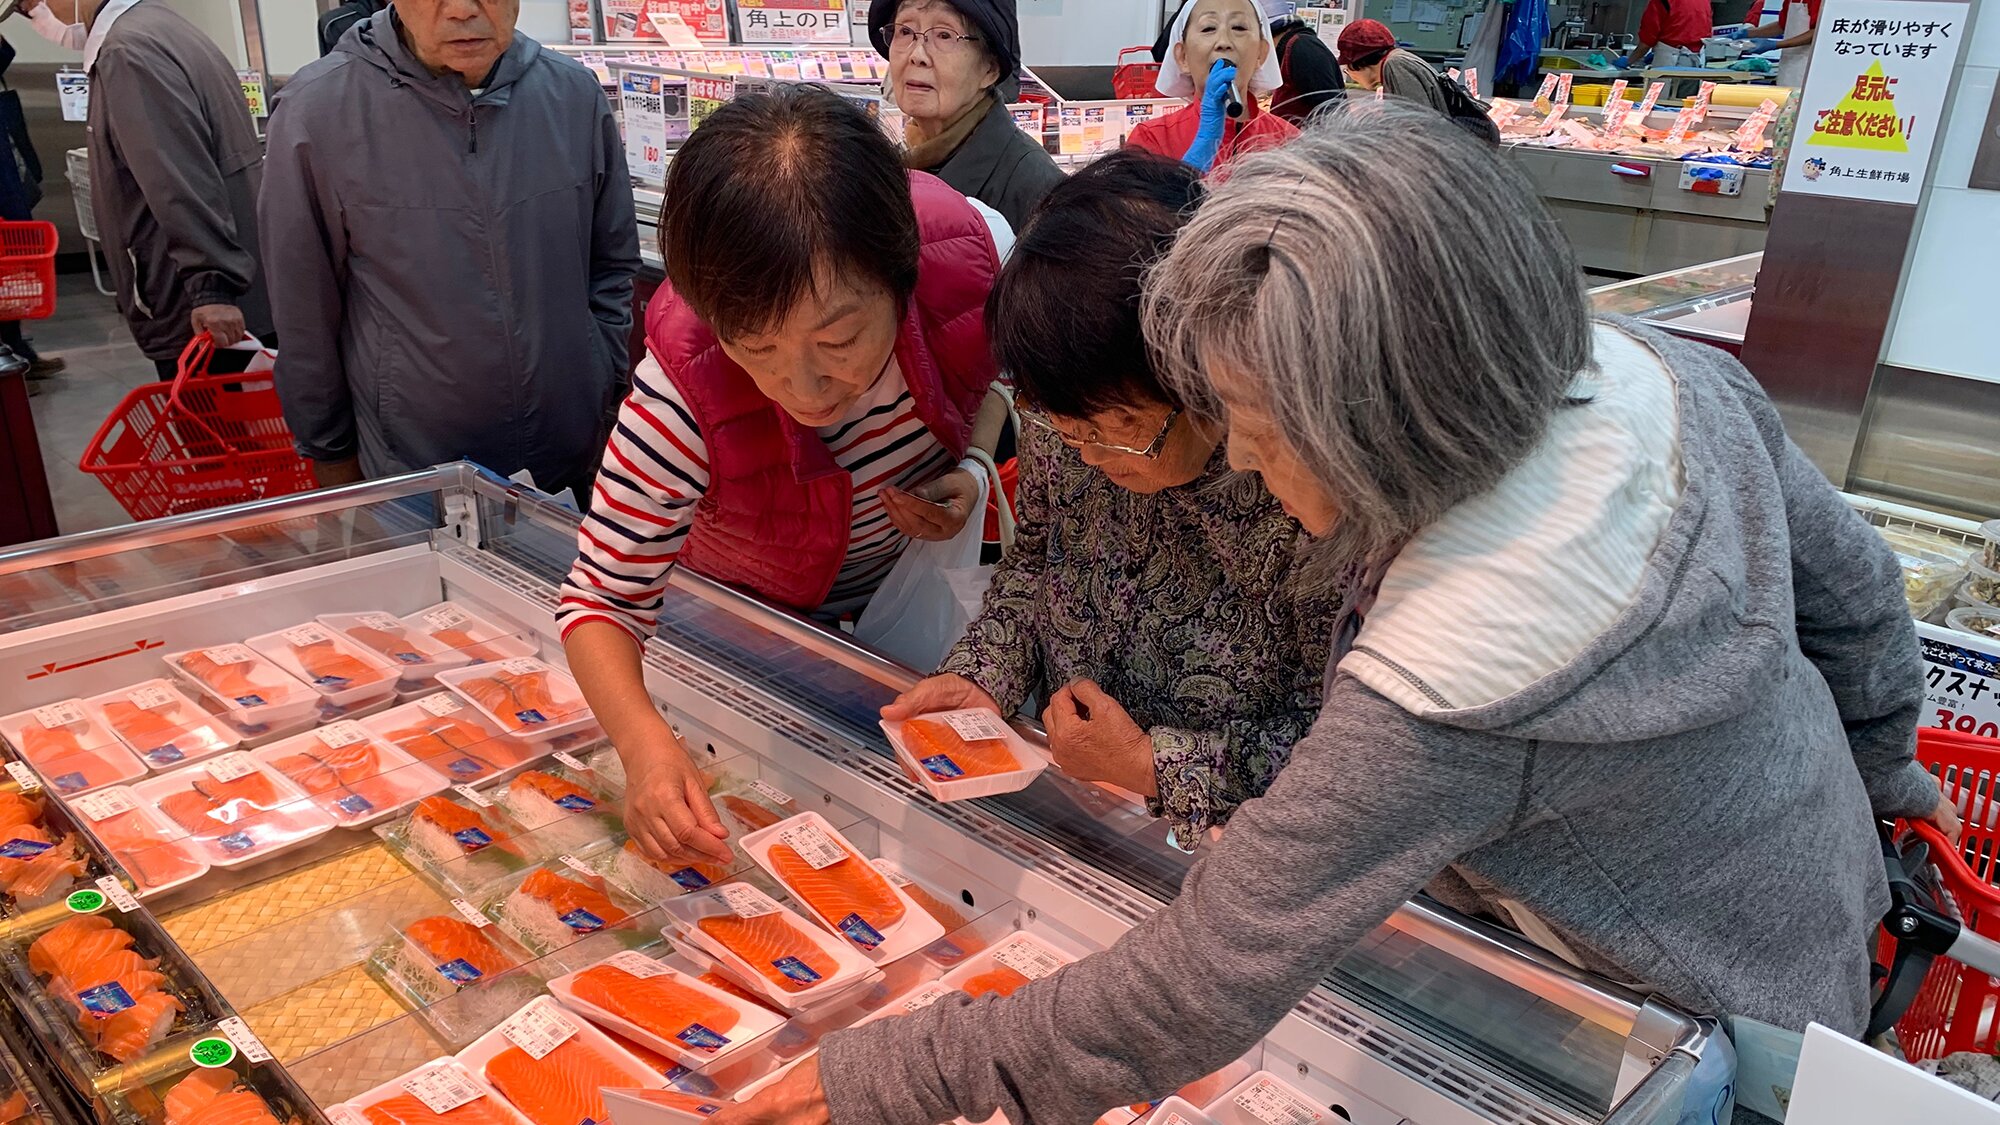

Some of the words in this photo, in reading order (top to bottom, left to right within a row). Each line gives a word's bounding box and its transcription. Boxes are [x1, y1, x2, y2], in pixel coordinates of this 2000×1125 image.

[746, 9, 840, 28] 角上の日
[1831, 18, 1952, 38] 床が滑りやすく
[1834, 40, 1938, 59] なっています
[62, 86, 87, 95] とろ
[690, 78, 733, 101] おすすめ品
[1851, 74, 1900, 101] 足元に
[644, 145, 659, 162] 180
[1829, 165, 1911, 184] 角上生鮮市場
[1931, 708, 1998, 738] 390
